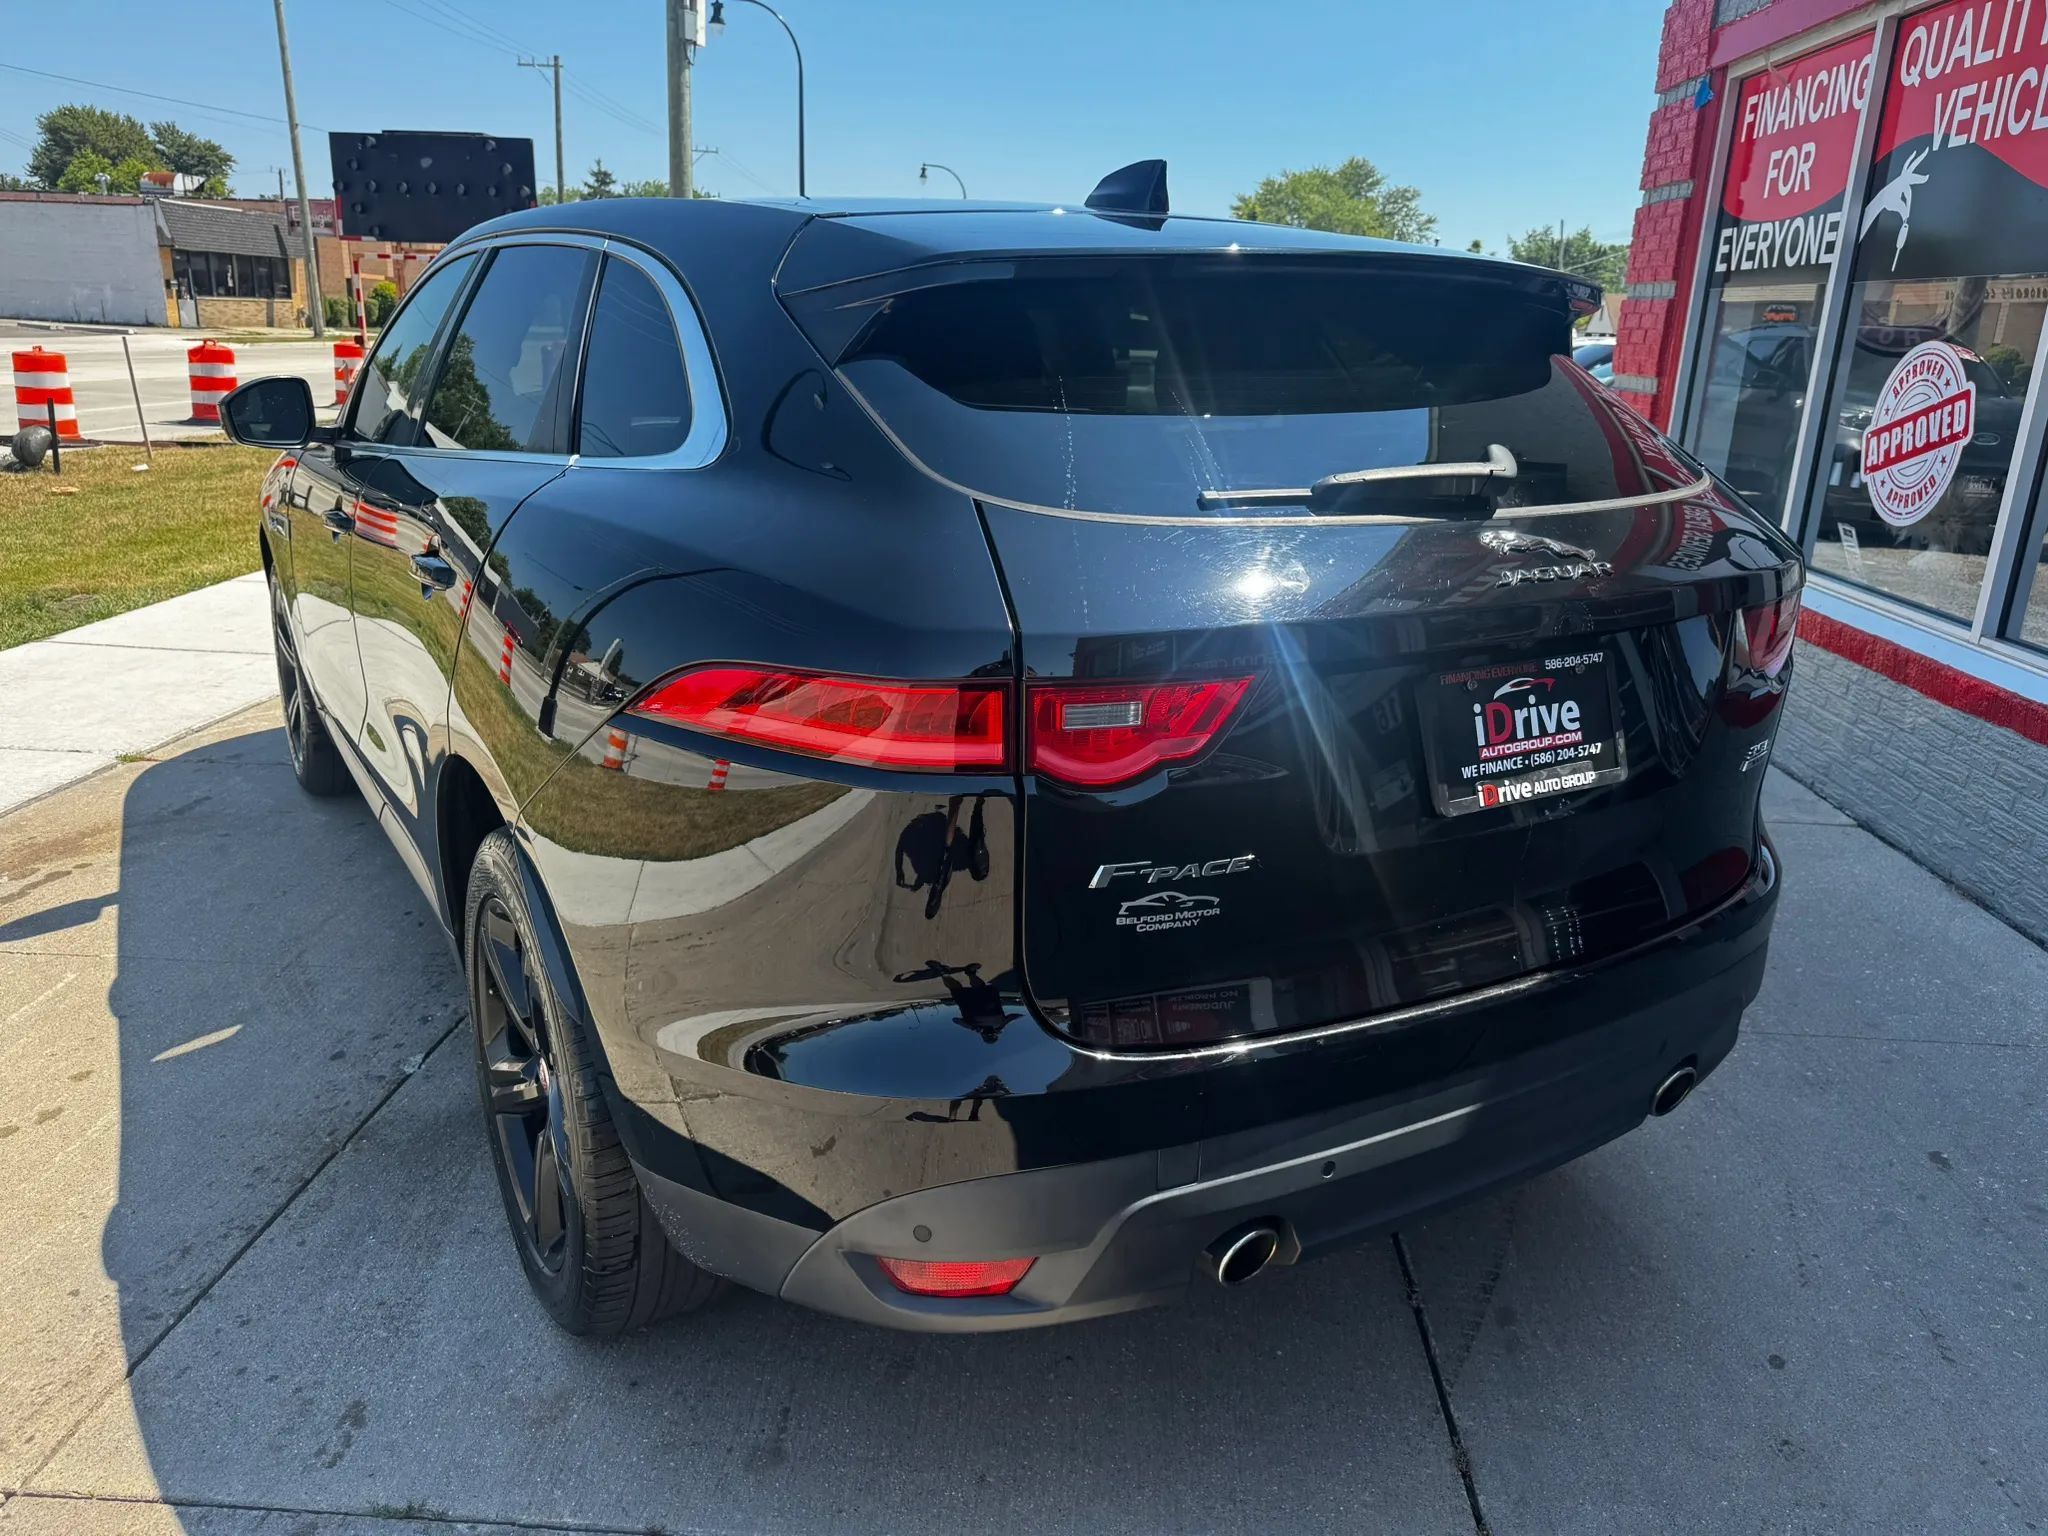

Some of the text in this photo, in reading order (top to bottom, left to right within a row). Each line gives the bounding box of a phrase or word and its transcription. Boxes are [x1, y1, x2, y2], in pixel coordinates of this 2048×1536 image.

[1740, 53, 1873, 142] FINANCING
[1763, 142, 1816, 199] FOR
[1715, 211, 1842, 272] EVERYONE
[1892, 359, 1945, 399] APPROVED
[1866, 399, 1967, 467] APPROVED
[1886, 476, 1937, 509] APPROVED
[1495, 562, 1615, 589] JAGUAR
[1545, 652, 1604, 671] 586-204-5747
[1473, 694, 1581, 746] iDrive
[1461, 742, 1602, 779] WE FINANCE (586) 204-5747
[1481, 731, 1583, 758] AUTOGROUP.COM
[1477, 771, 1596, 808] iDrive AUTO GROUP
[1116, 908, 1220, 926] BELFORD MOTOR
[1136, 918, 1200, 933] COMPANY
